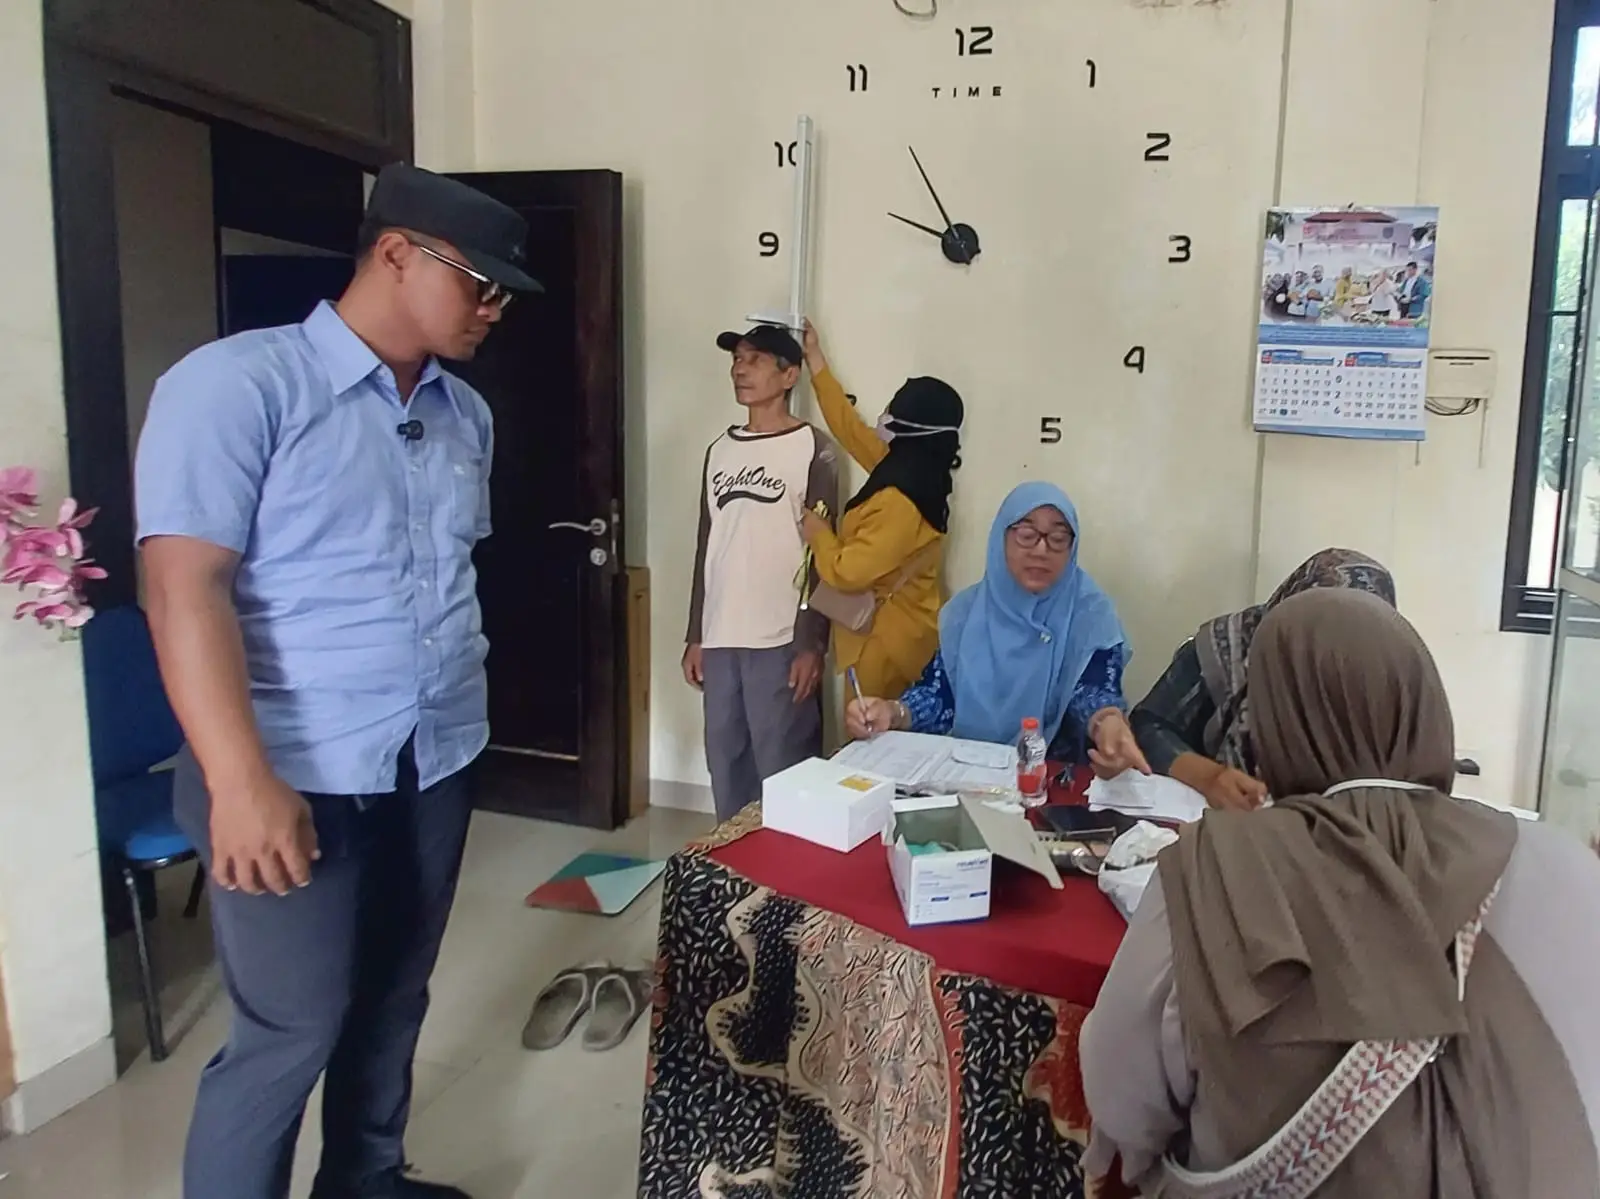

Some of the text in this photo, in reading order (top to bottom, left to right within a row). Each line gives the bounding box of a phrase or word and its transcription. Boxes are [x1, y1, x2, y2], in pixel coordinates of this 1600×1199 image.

[955, 27, 993, 56] 12
[847, 64, 867, 91] 11
[1087, 60, 1095, 88] 1
[932, 86, 1001, 98] TIME
[1145, 133, 1170, 161] 2
[759, 232, 779, 256] 9
[1169, 236, 1191, 263] 3
[1124, 346, 1144, 373] 4
[1041, 417, 1061, 443] 5
